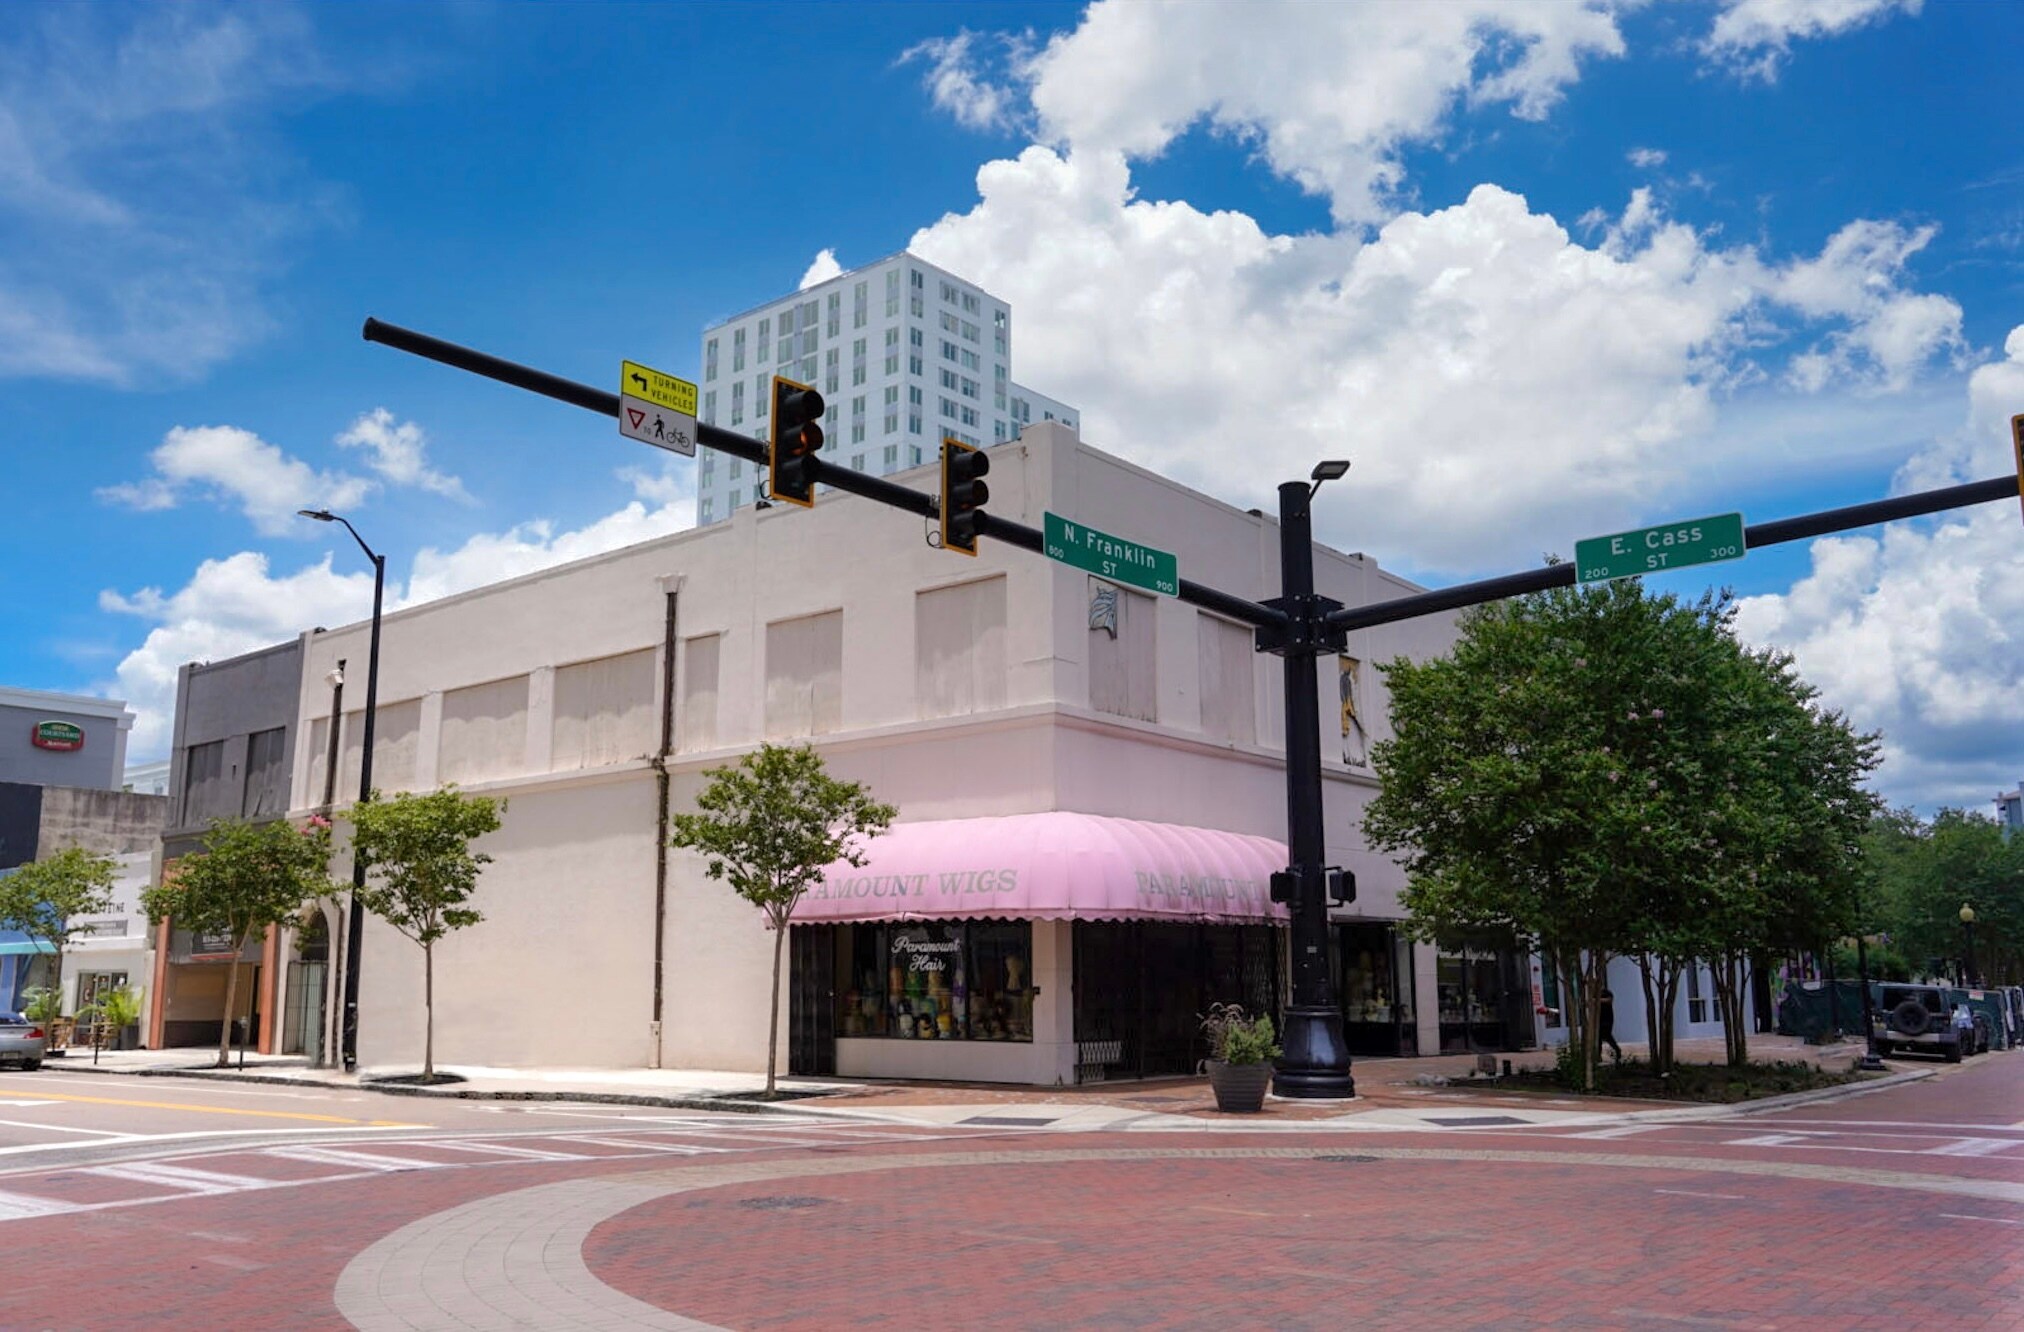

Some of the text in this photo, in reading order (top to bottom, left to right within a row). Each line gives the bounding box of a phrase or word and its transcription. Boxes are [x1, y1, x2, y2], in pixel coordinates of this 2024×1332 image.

[653, 375, 693, 397] TURNING
[651, 389, 693, 411] VEHICLES
[1064, 523, 1156, 569] N. Franklin
[1611, 527, 1703, 556] E. Cass
[1646, 553, 1669, 569] ST
[1710, 545, 1736, 559] 300
[1102, 560, 1118, 577] ST
[1585, 567, 1609, 580] 200
[1156, 580, 1174, 593] 900
[938, 868, 1018, 896] WIGS
[891, 935, 961, 953] Paramount
[909, 954, 946, 972] Hair
